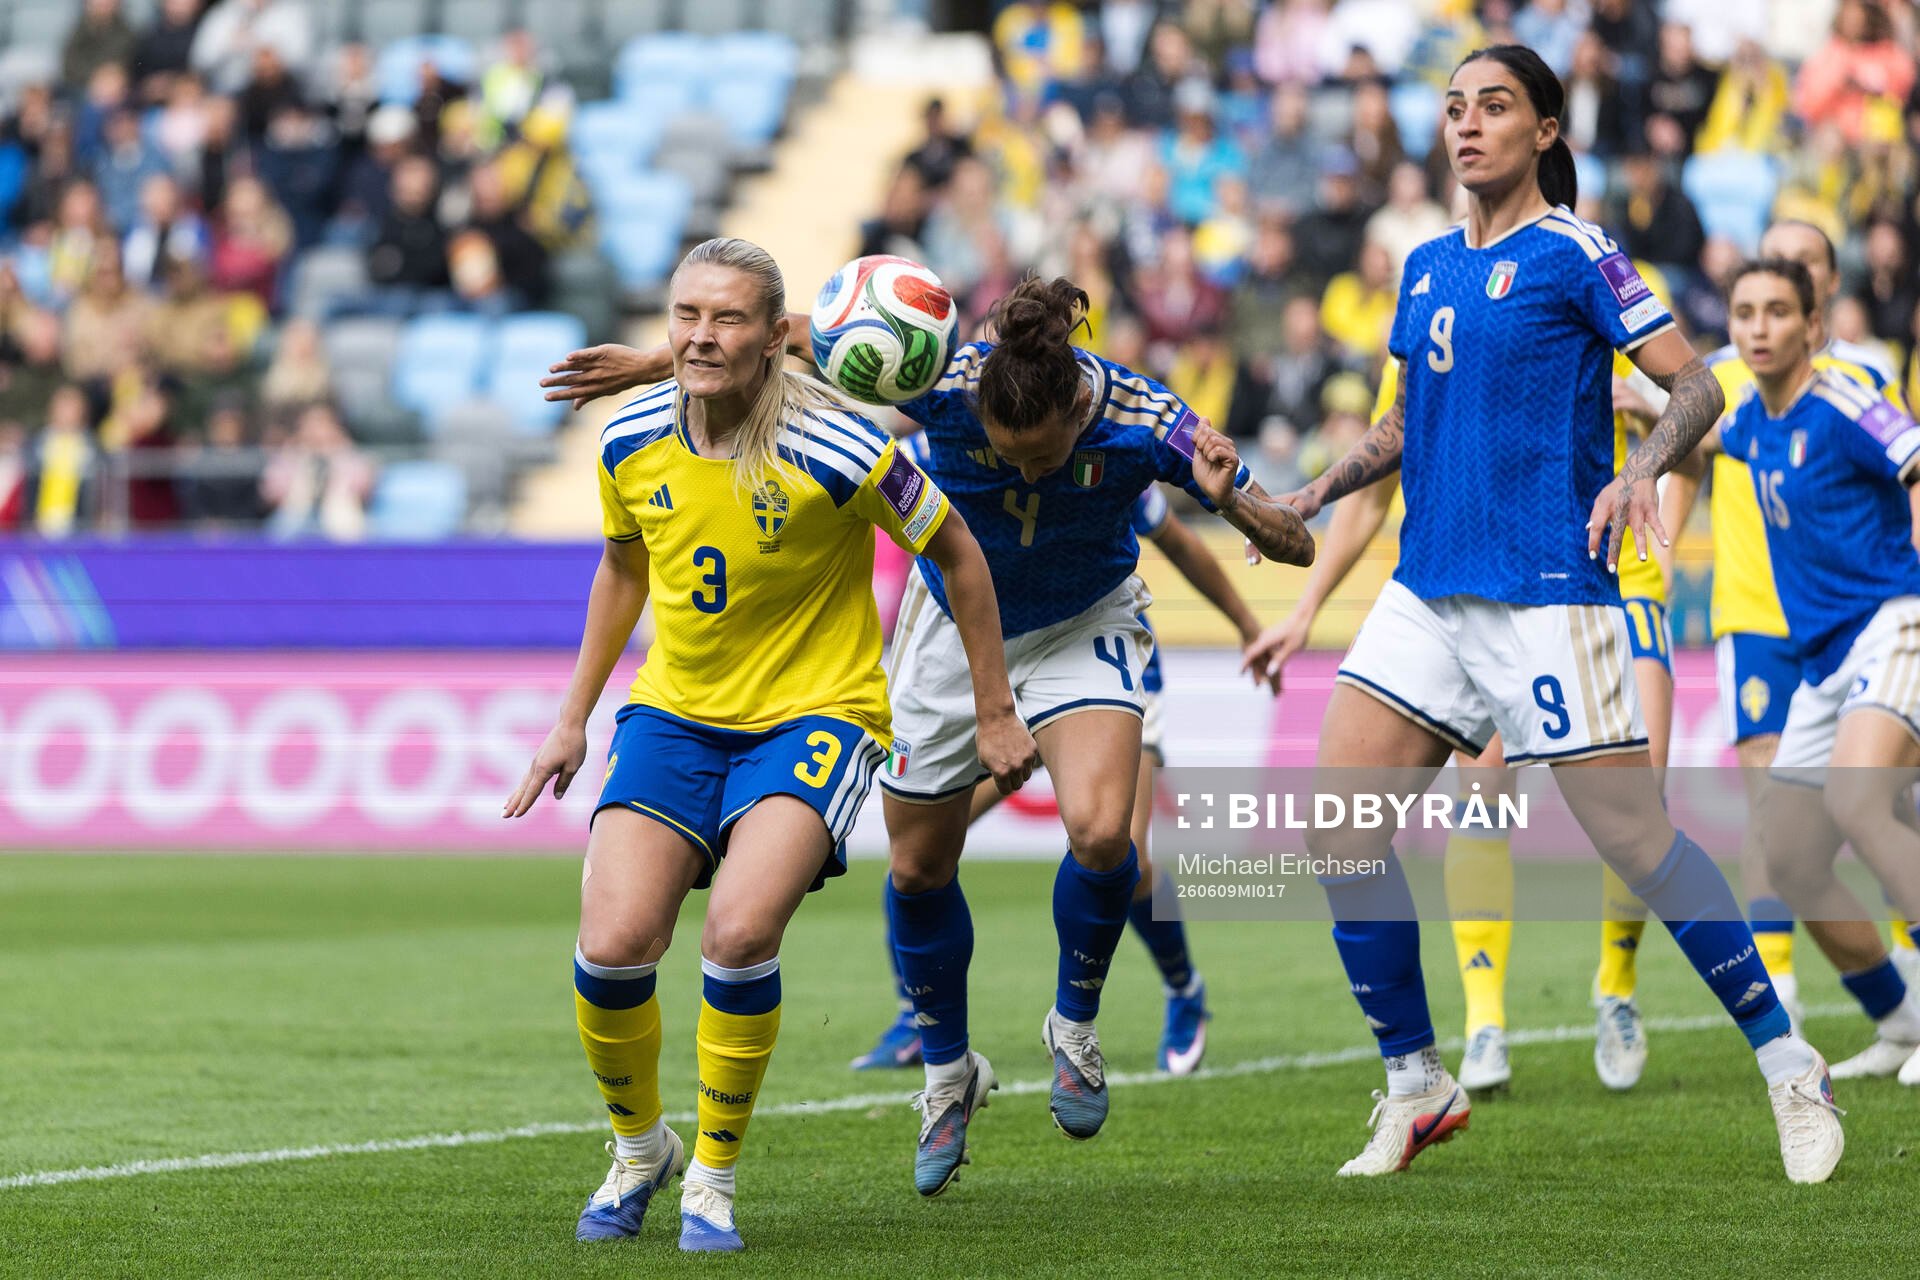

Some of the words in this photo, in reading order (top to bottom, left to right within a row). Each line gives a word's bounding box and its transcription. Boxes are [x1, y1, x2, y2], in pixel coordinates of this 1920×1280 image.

[1428, 306, 1455, 373] 9
[898, 472, 919, 507] EUROPEAN
[1003, 489, 1040, 547] 4
[1759, 470, 1790, 530] 15
[691, 545, 727, 614] 3
[1626, 600, 1666, 656] 11
[1093, 636, 1134, 691] 4
[1532, 675, 1570, 739] 9
[793, 730, 842, 789] 3
[1711, 945, 1754, 977] ITALIA
[700, 1080, 753, 1104] SVERIGE
